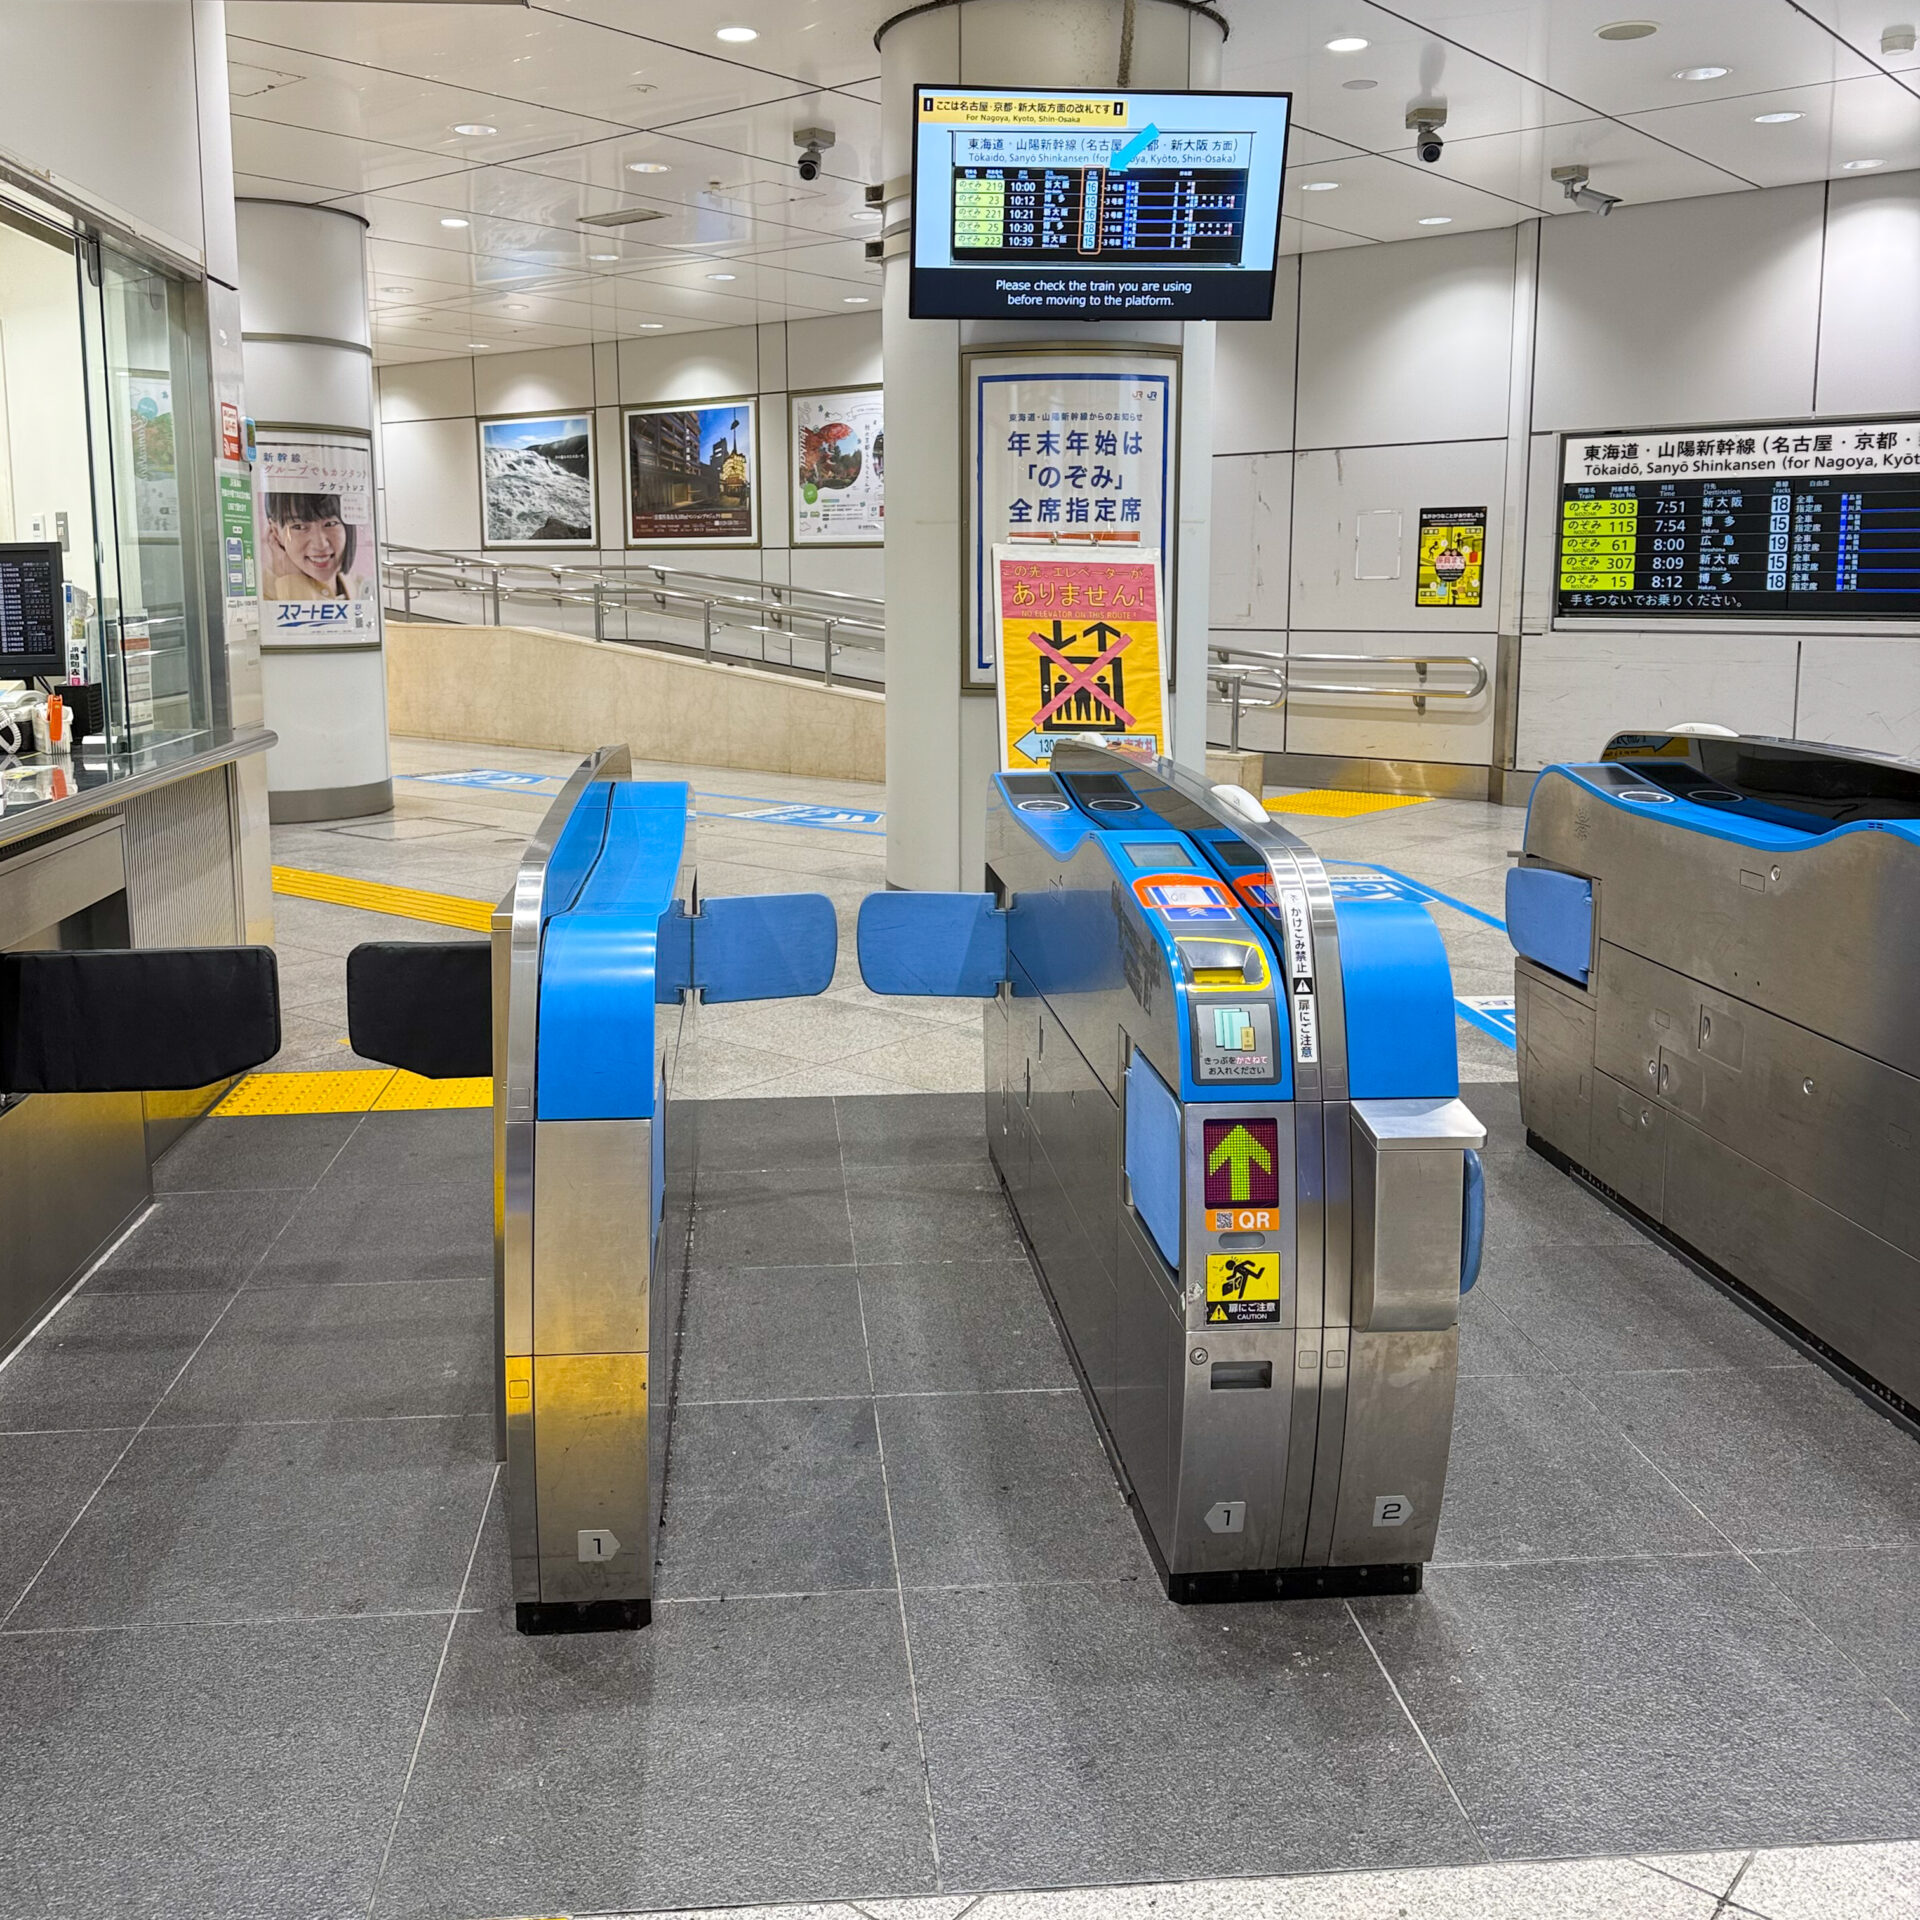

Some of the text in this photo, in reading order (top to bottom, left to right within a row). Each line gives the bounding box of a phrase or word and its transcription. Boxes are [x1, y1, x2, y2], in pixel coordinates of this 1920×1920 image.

[936, 101, 1111, 114] ここは名古屋・京都・新大阪方面の改札です
[980, 114, 1010, 123] Nagoya,
[1013, 115, 1036, 123] Kyoto,
[1038, 154, 1089, 163] Shinkansen
[986, 182, 1003, 191] 219
[1011, 182, 1036, 191] 10:00
[1087, 182, 1096, 192] 16
[988, 196, 1000, 205] 23
[1010, 196, 1035, 205] 10:12
[1086, 196, 1096, 206] 19
[986, 209, 1001, 218] 221
[1009, 210, 1034, 219] 10:21
[1086, 210, 1095, 219] 16
[987, 223, 999, 232] 25
[1009, 223, 1034, 232] 10:30
[1085, 224, 1094, 233] 18
[984, 236, 1001, 246] 223
[1008, 237, 1034, 246] 10:39
[1084, 237, 1093, 247] 15
[995, 280, 1192, 294] Please check the train you are using
[1007, 294, 1174, 308] before moving to the platform.
[1008, 412, 1143, 422] 東海道・山陽新幹線からのお知らせ
[1007, 430, 1143, 456] 年末年始は
[1583, 430, 1920, 461] 東海道・山陽新幹線(名古屋・京都・
[1584, 463, 1643, 476] Tōkaidō,
[1646, 462, 1689, 476] Sanyō
[1692, 459, 1776, 472] Shinkansen
[1782, 456, 1810, 470] (for
[1814, 455, 1878, 470] Nagoya,
[1028, 464, 1123, 490] 「のぞみ」
[1009, 497, 1142, 523] 全席指定席
[1569, 497, 1788, 514] のぞみ 303 7:51 新大阪 18
[1568, 521, 1602, 529] のぞみ
[1609, 521, 1634, 533] 115
[1655, 520, 1686, 532] 7:54
[1771, 517, 1787, 530] 15
[1567, 535, 1787, 551] のぞみ 61 8:00 広島 19
[1566, 554, 1785, 569] のぞみ 307 8:09 新大阪 15
[1565, 575, 1599, 584] のぞみ
[1611, 576, 1627, 587] 15
[1651, 575, 1683, 588] 8:12
[1768, 575, 1784, 588] 18
[277, 604, 348, 620] スマートEX
[1034, 610, 1073, 618] ELEVATOR
[1089, 611, 1105, 619] THIS
[1291, 907, 1308, 974] かけこみ禁止
[1298, 999, 1313, 1058] 扉にご注意
[1204, 1056, 1268, 1065] きっぷをかさねて
[1209, 1066, 1265, 1075] お入れください
[1238, 1211, 1270, 1229] QR
[1228, 1302, 1276, 1313] 扉にご注意
[1223, 1509, 1232, 1526] 1
[1382, 1503, 1401, 1520] 2
[592, 1538, 601, 1555] 1
